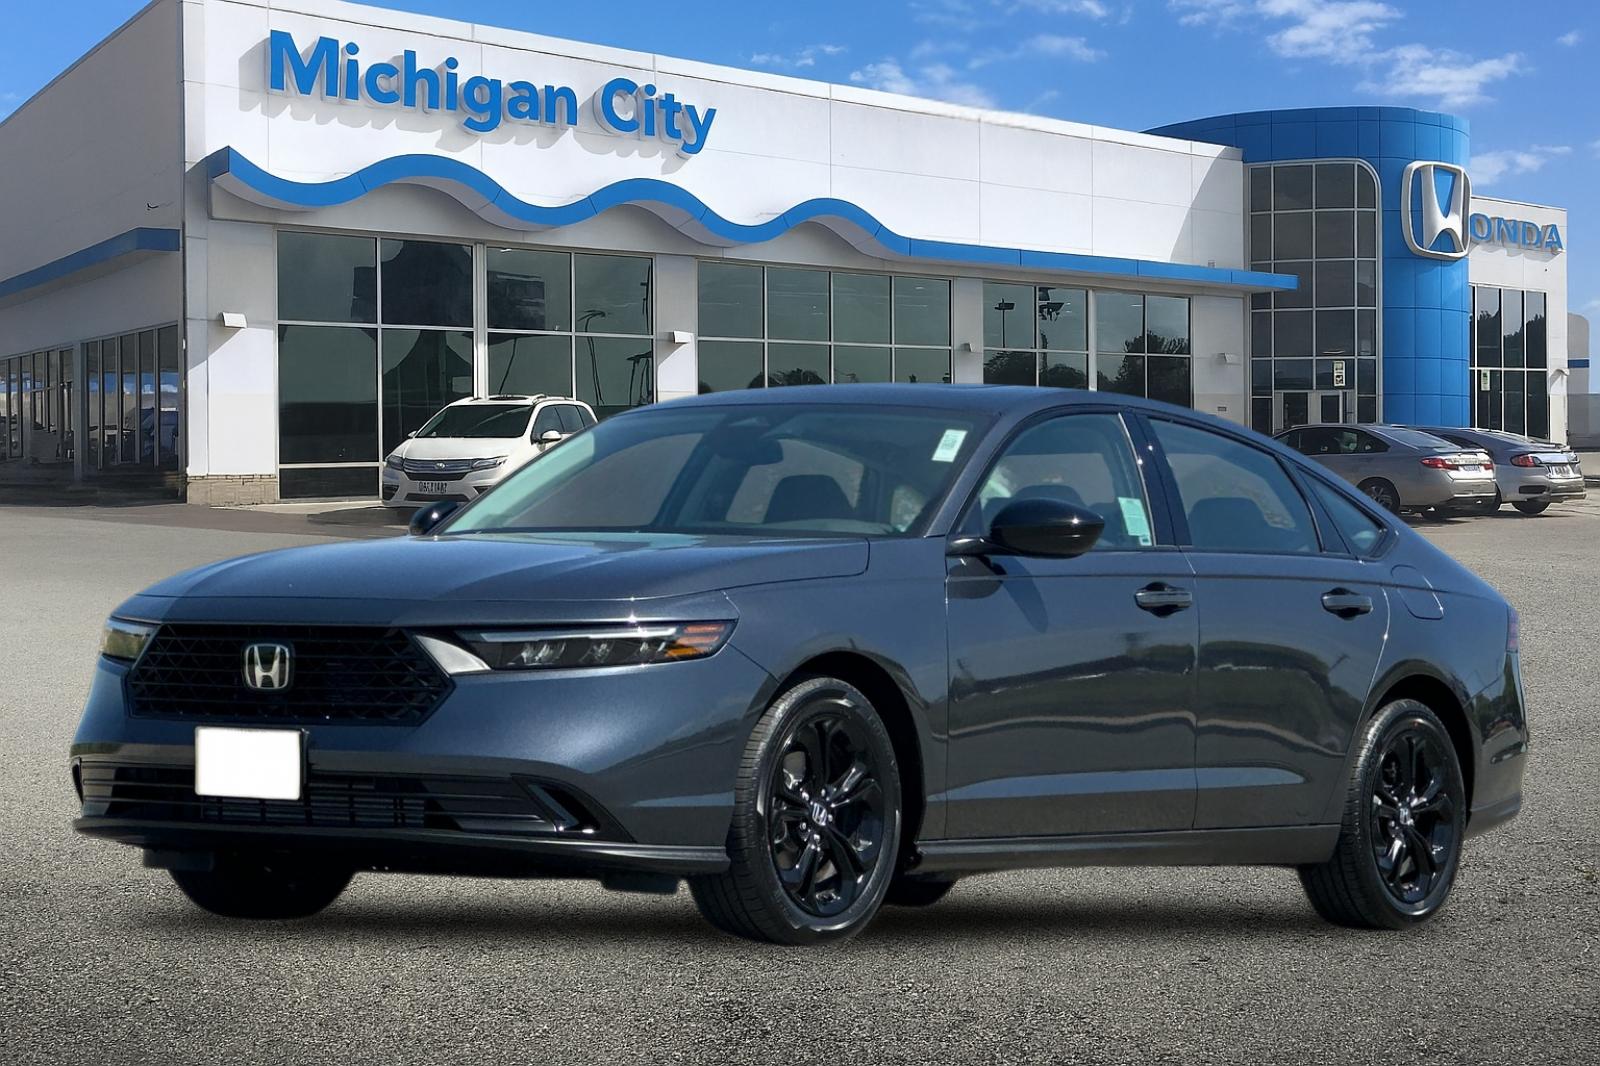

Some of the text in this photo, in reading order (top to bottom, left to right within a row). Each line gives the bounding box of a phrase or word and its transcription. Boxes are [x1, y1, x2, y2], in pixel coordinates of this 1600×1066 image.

[270, 29, 717, 155] Michigan City
[1469, 212, 1563, 250] ONDA
